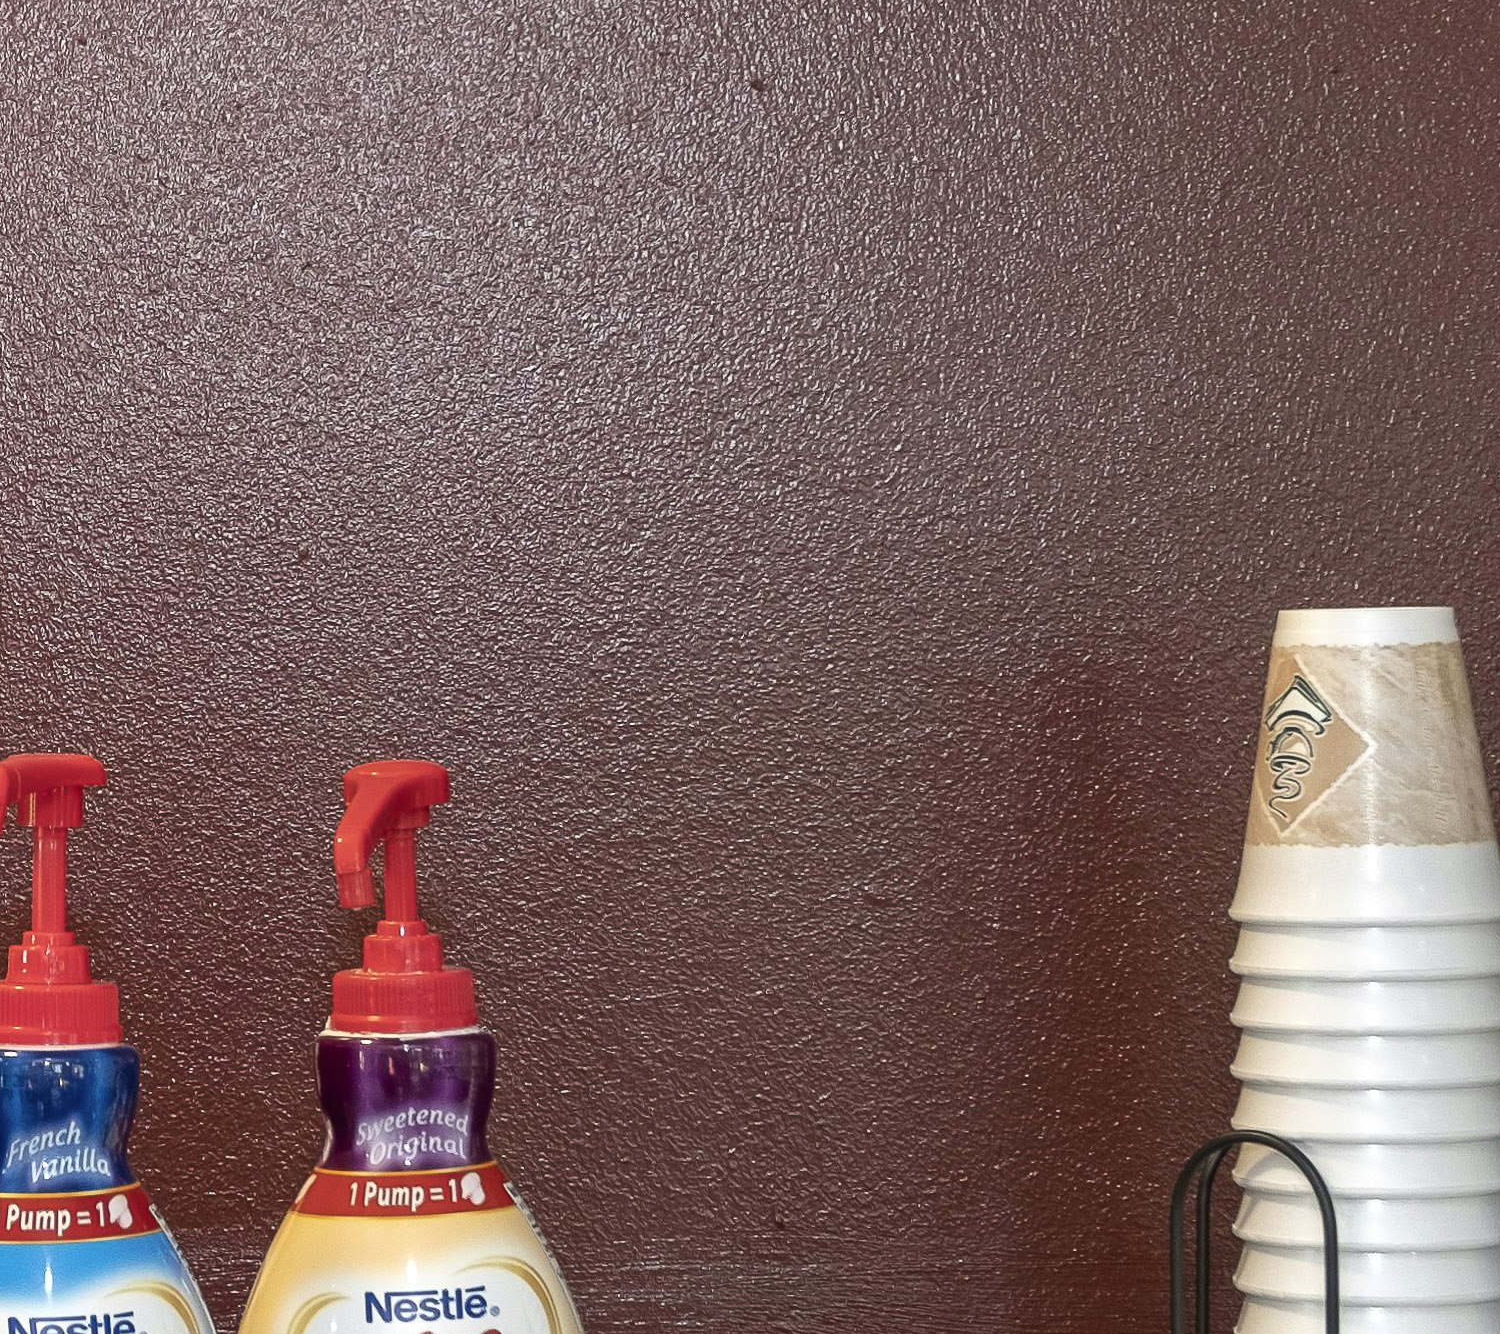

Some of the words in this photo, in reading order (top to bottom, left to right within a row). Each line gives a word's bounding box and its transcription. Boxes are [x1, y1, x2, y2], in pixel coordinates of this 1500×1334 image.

[5, 1121, 81, 1168] French
[356, 1107, 470, 1147] Sweetened
[369, 1131, 468, 1165] Original
[31, 1148, 111, 1184] Vanilla
[350, 1181, 358, 1206] 1
[364, 1181, 425, 1212] Pump
[449, 1178, 458, 1203] 1
[6, 1204, 72, 1237] Pump
[96, 1202, 105, 1228] 1
